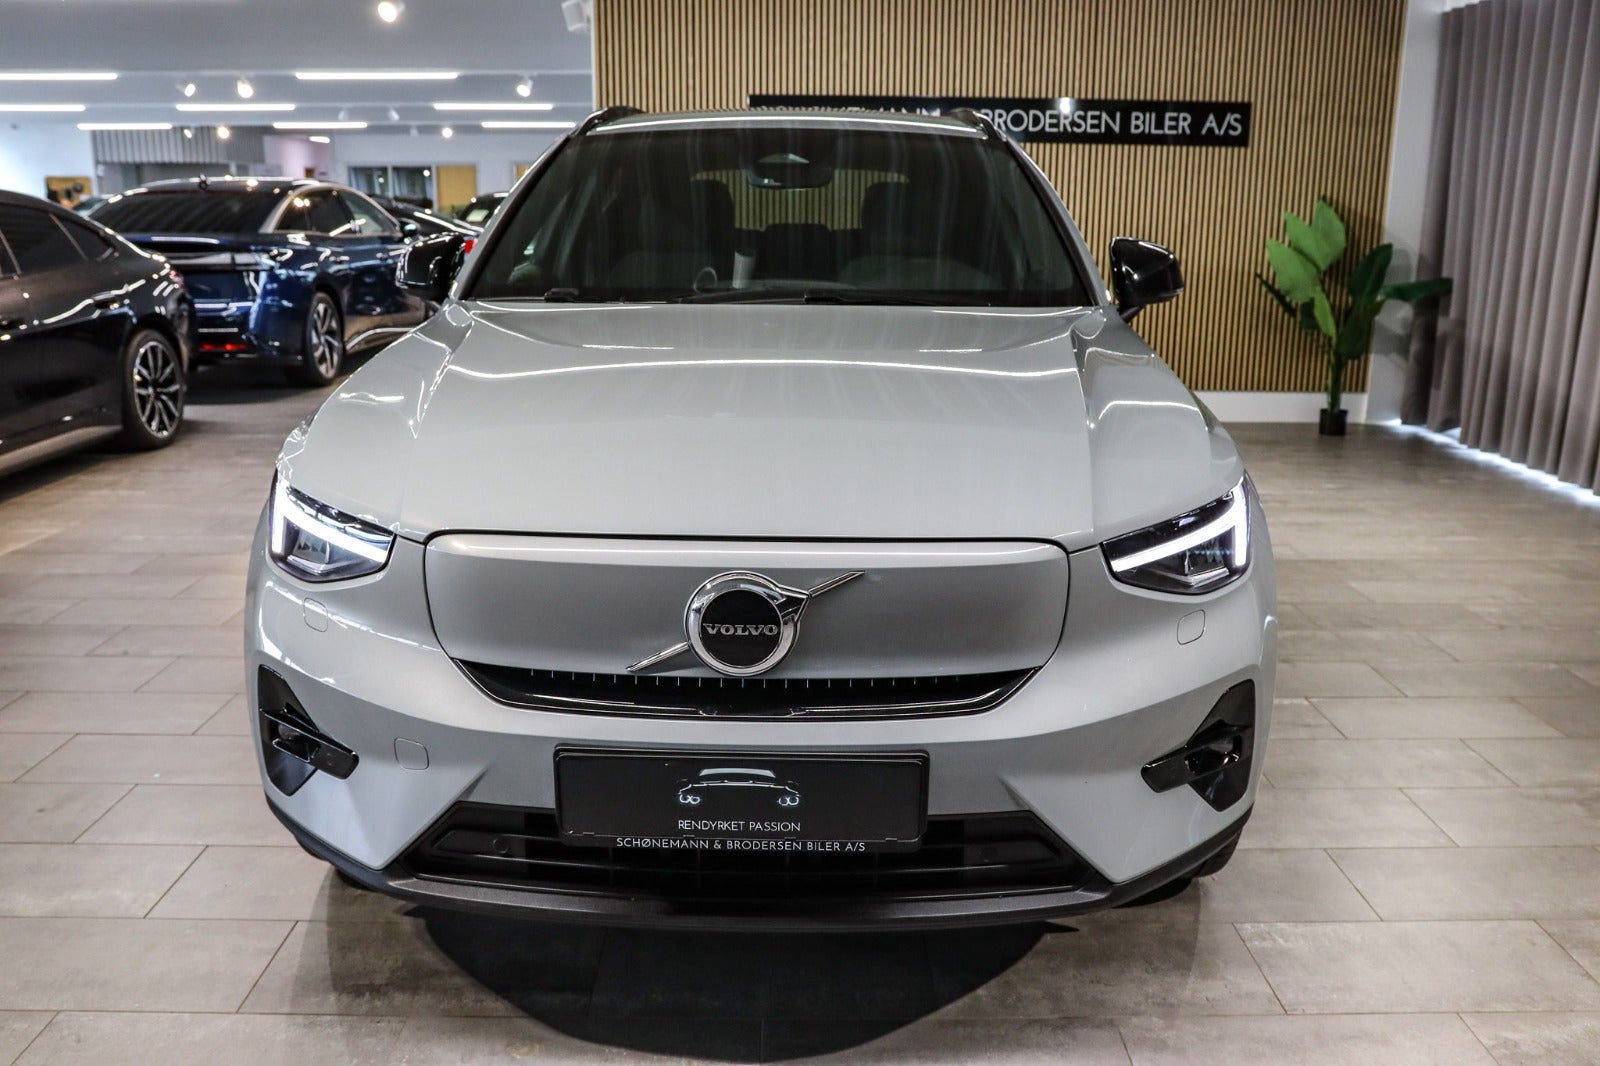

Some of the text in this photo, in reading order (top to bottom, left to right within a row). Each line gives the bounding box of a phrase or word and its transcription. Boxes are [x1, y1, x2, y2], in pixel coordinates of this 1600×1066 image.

[1130, 111, 1192, 135] BILER
[1201, 112, 1242, 137] A/S
[703, 623, 779, 636] VOLVO
[678, 820, 801, 832] RENDYRKET PASSION
[616, 837, 866, 852] SCHØNEMANN & BRODERSEN BILER A/S
